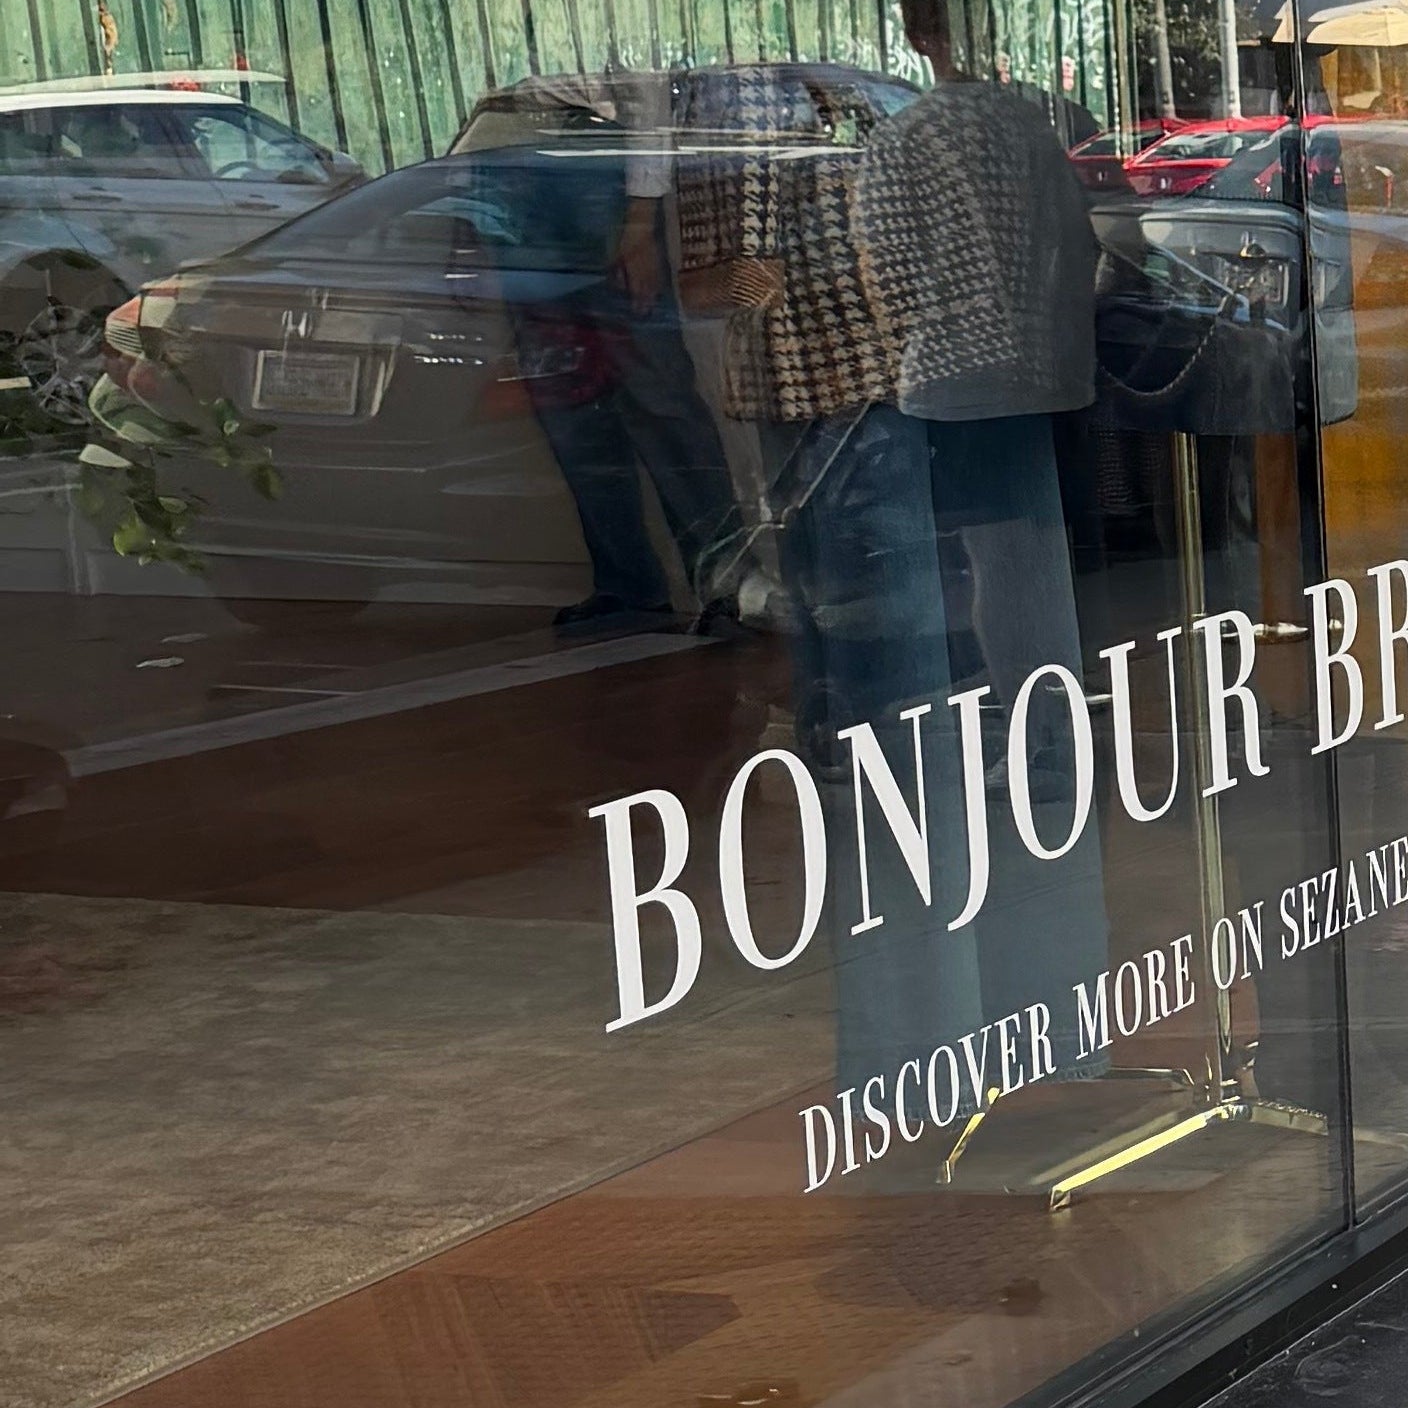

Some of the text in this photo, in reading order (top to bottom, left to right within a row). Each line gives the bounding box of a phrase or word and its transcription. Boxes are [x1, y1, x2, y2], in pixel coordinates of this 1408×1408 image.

[588, 609, 1271, 1033] BONJOUR
[800, 977, 1058, 1193] DISCOVER
[1074, 932, 1199, 1060] MORE
[1210, 901, 1268, 992] ON
